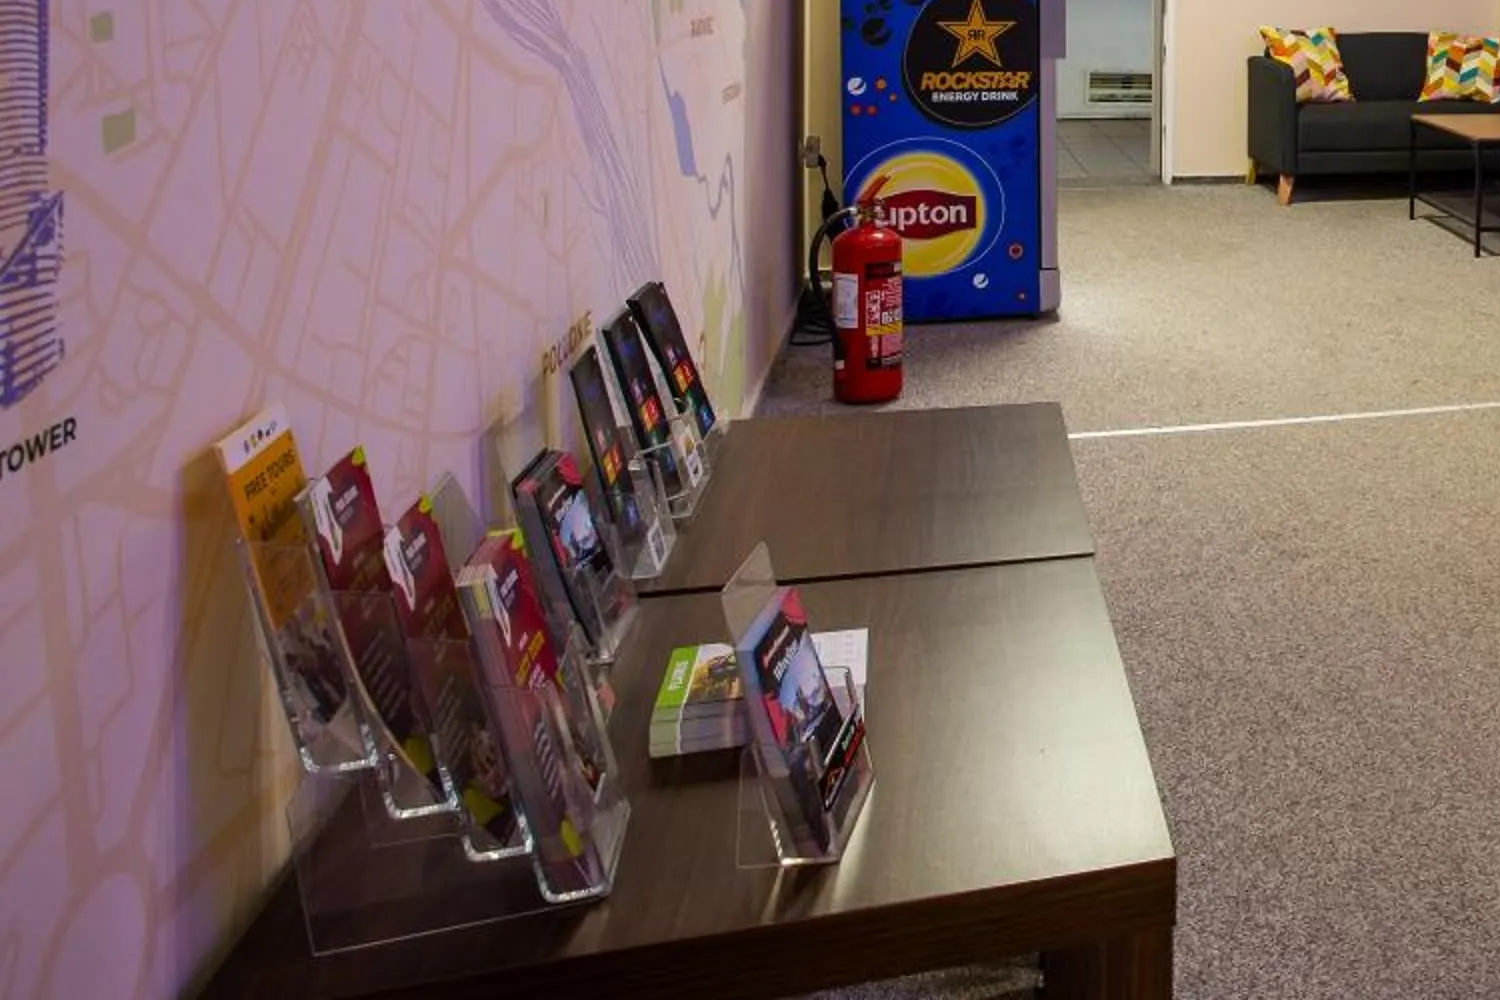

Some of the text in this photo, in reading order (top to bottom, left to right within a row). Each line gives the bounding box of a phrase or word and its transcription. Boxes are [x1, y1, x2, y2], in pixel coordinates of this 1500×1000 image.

[921, 70, 1032, 91] ROCKSTAR
[931, 90, 1019, 103] ENERGY DRINK
